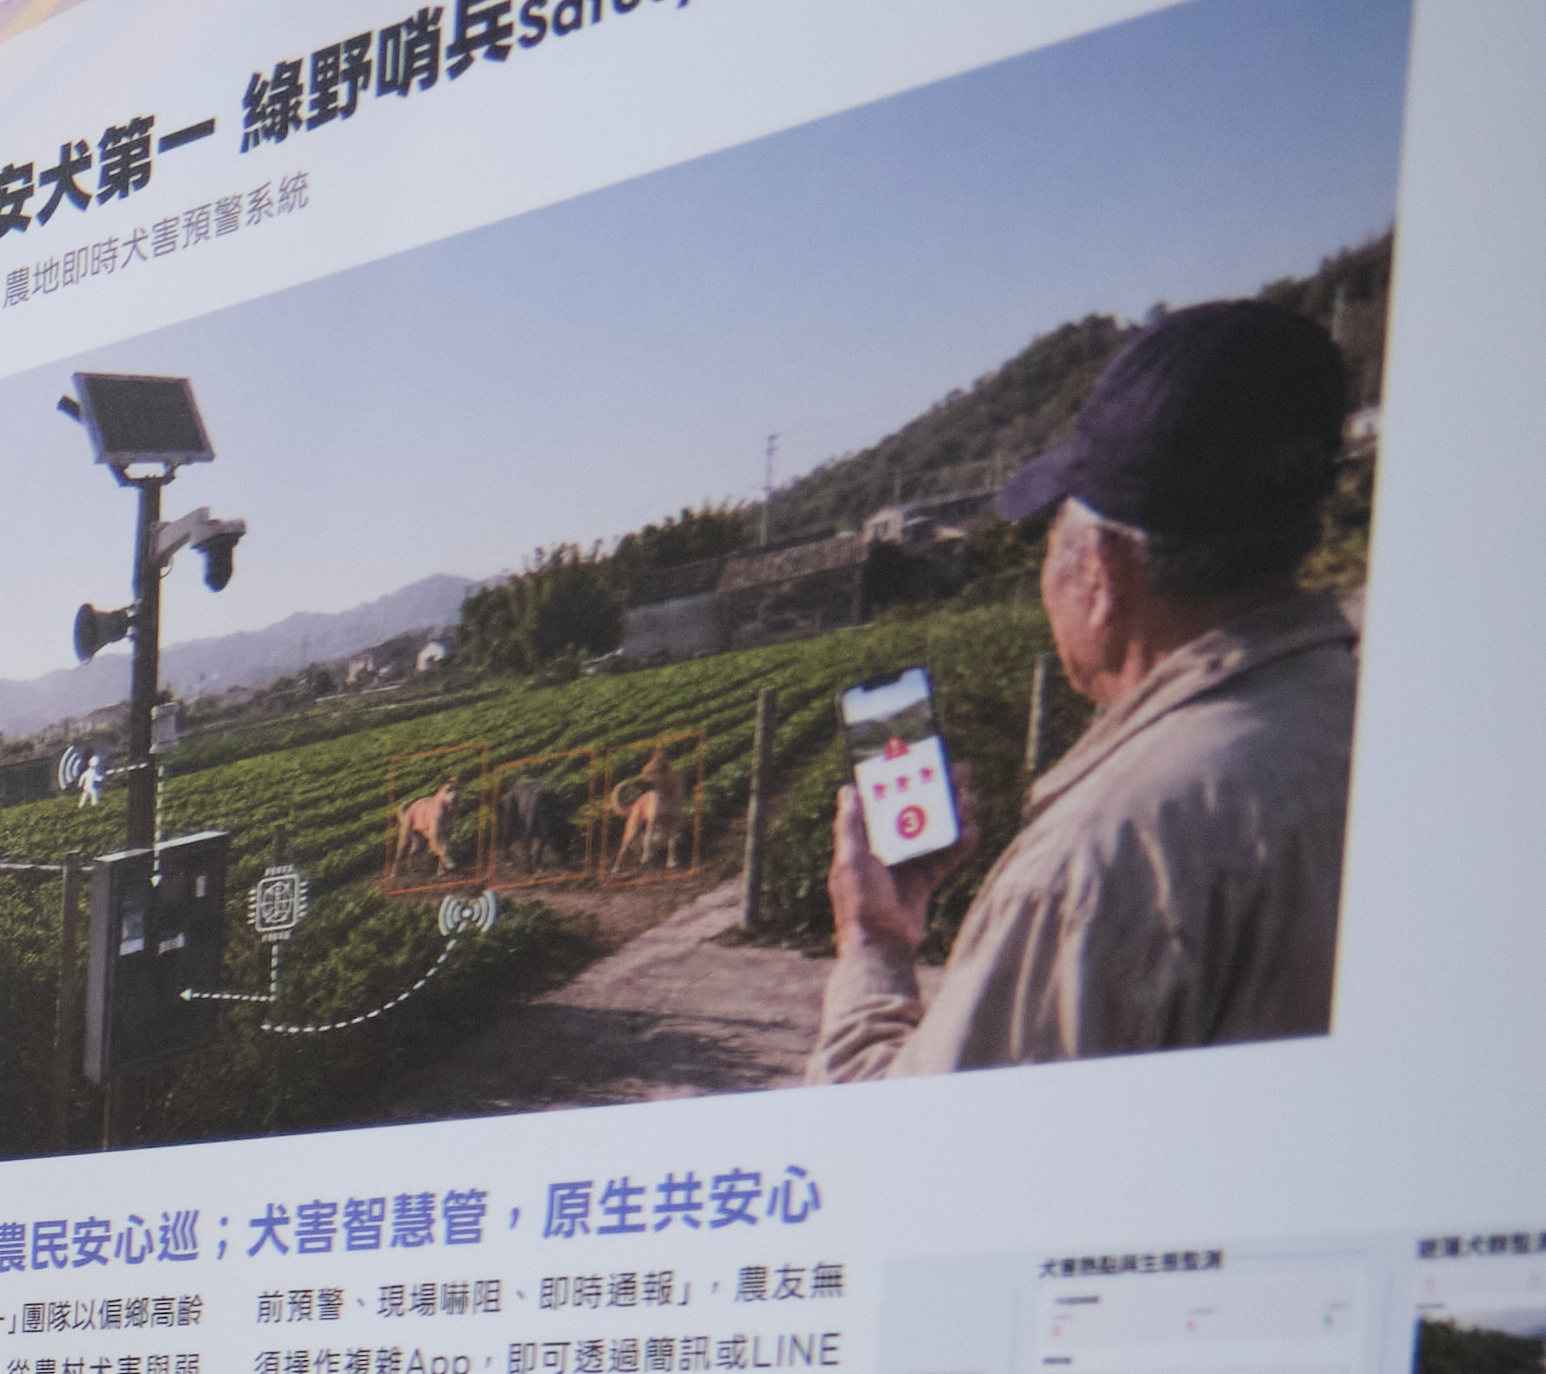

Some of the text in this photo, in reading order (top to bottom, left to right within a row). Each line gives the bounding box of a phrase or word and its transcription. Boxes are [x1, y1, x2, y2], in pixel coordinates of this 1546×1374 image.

[239, 0, 690, 153] 綠野哨兵sa
[2, 170, 311, 311] 農地即時犬害預警系統
